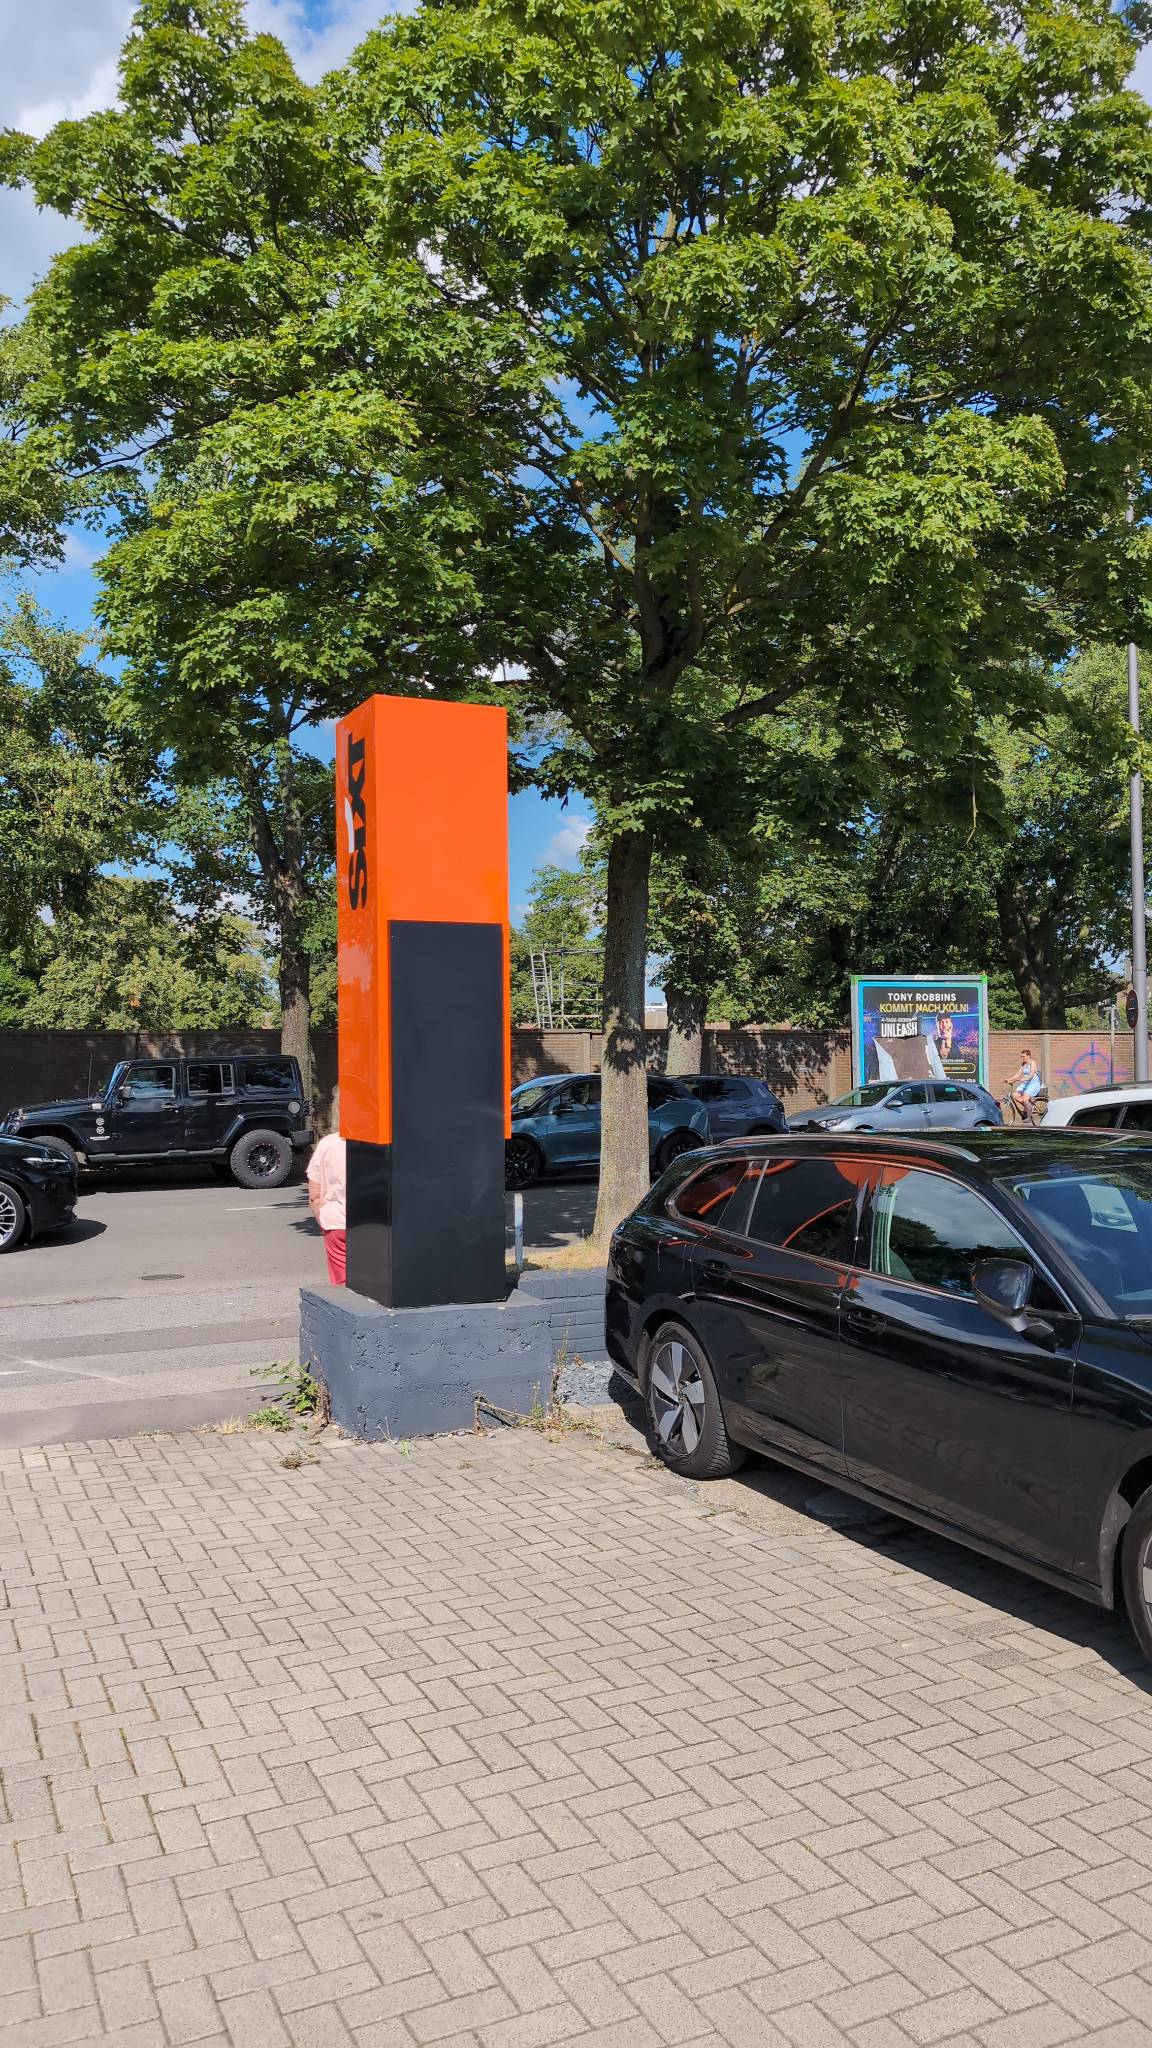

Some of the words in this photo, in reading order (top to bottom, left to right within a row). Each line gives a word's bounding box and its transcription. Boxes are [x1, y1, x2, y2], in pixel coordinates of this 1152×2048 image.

[344, 732, 368, 911] SIXT
[887, 992, 914, 1002] TONY
[915, 992, 957, 1002] ROBBINS
[879, 1003, 914, 1013] KOMMT
[915, 1003, 940, 1013] NACH
[942, 1001, 969, 1013] KÖLN!
[881, 1021, 918, 1038] UNLEASH
